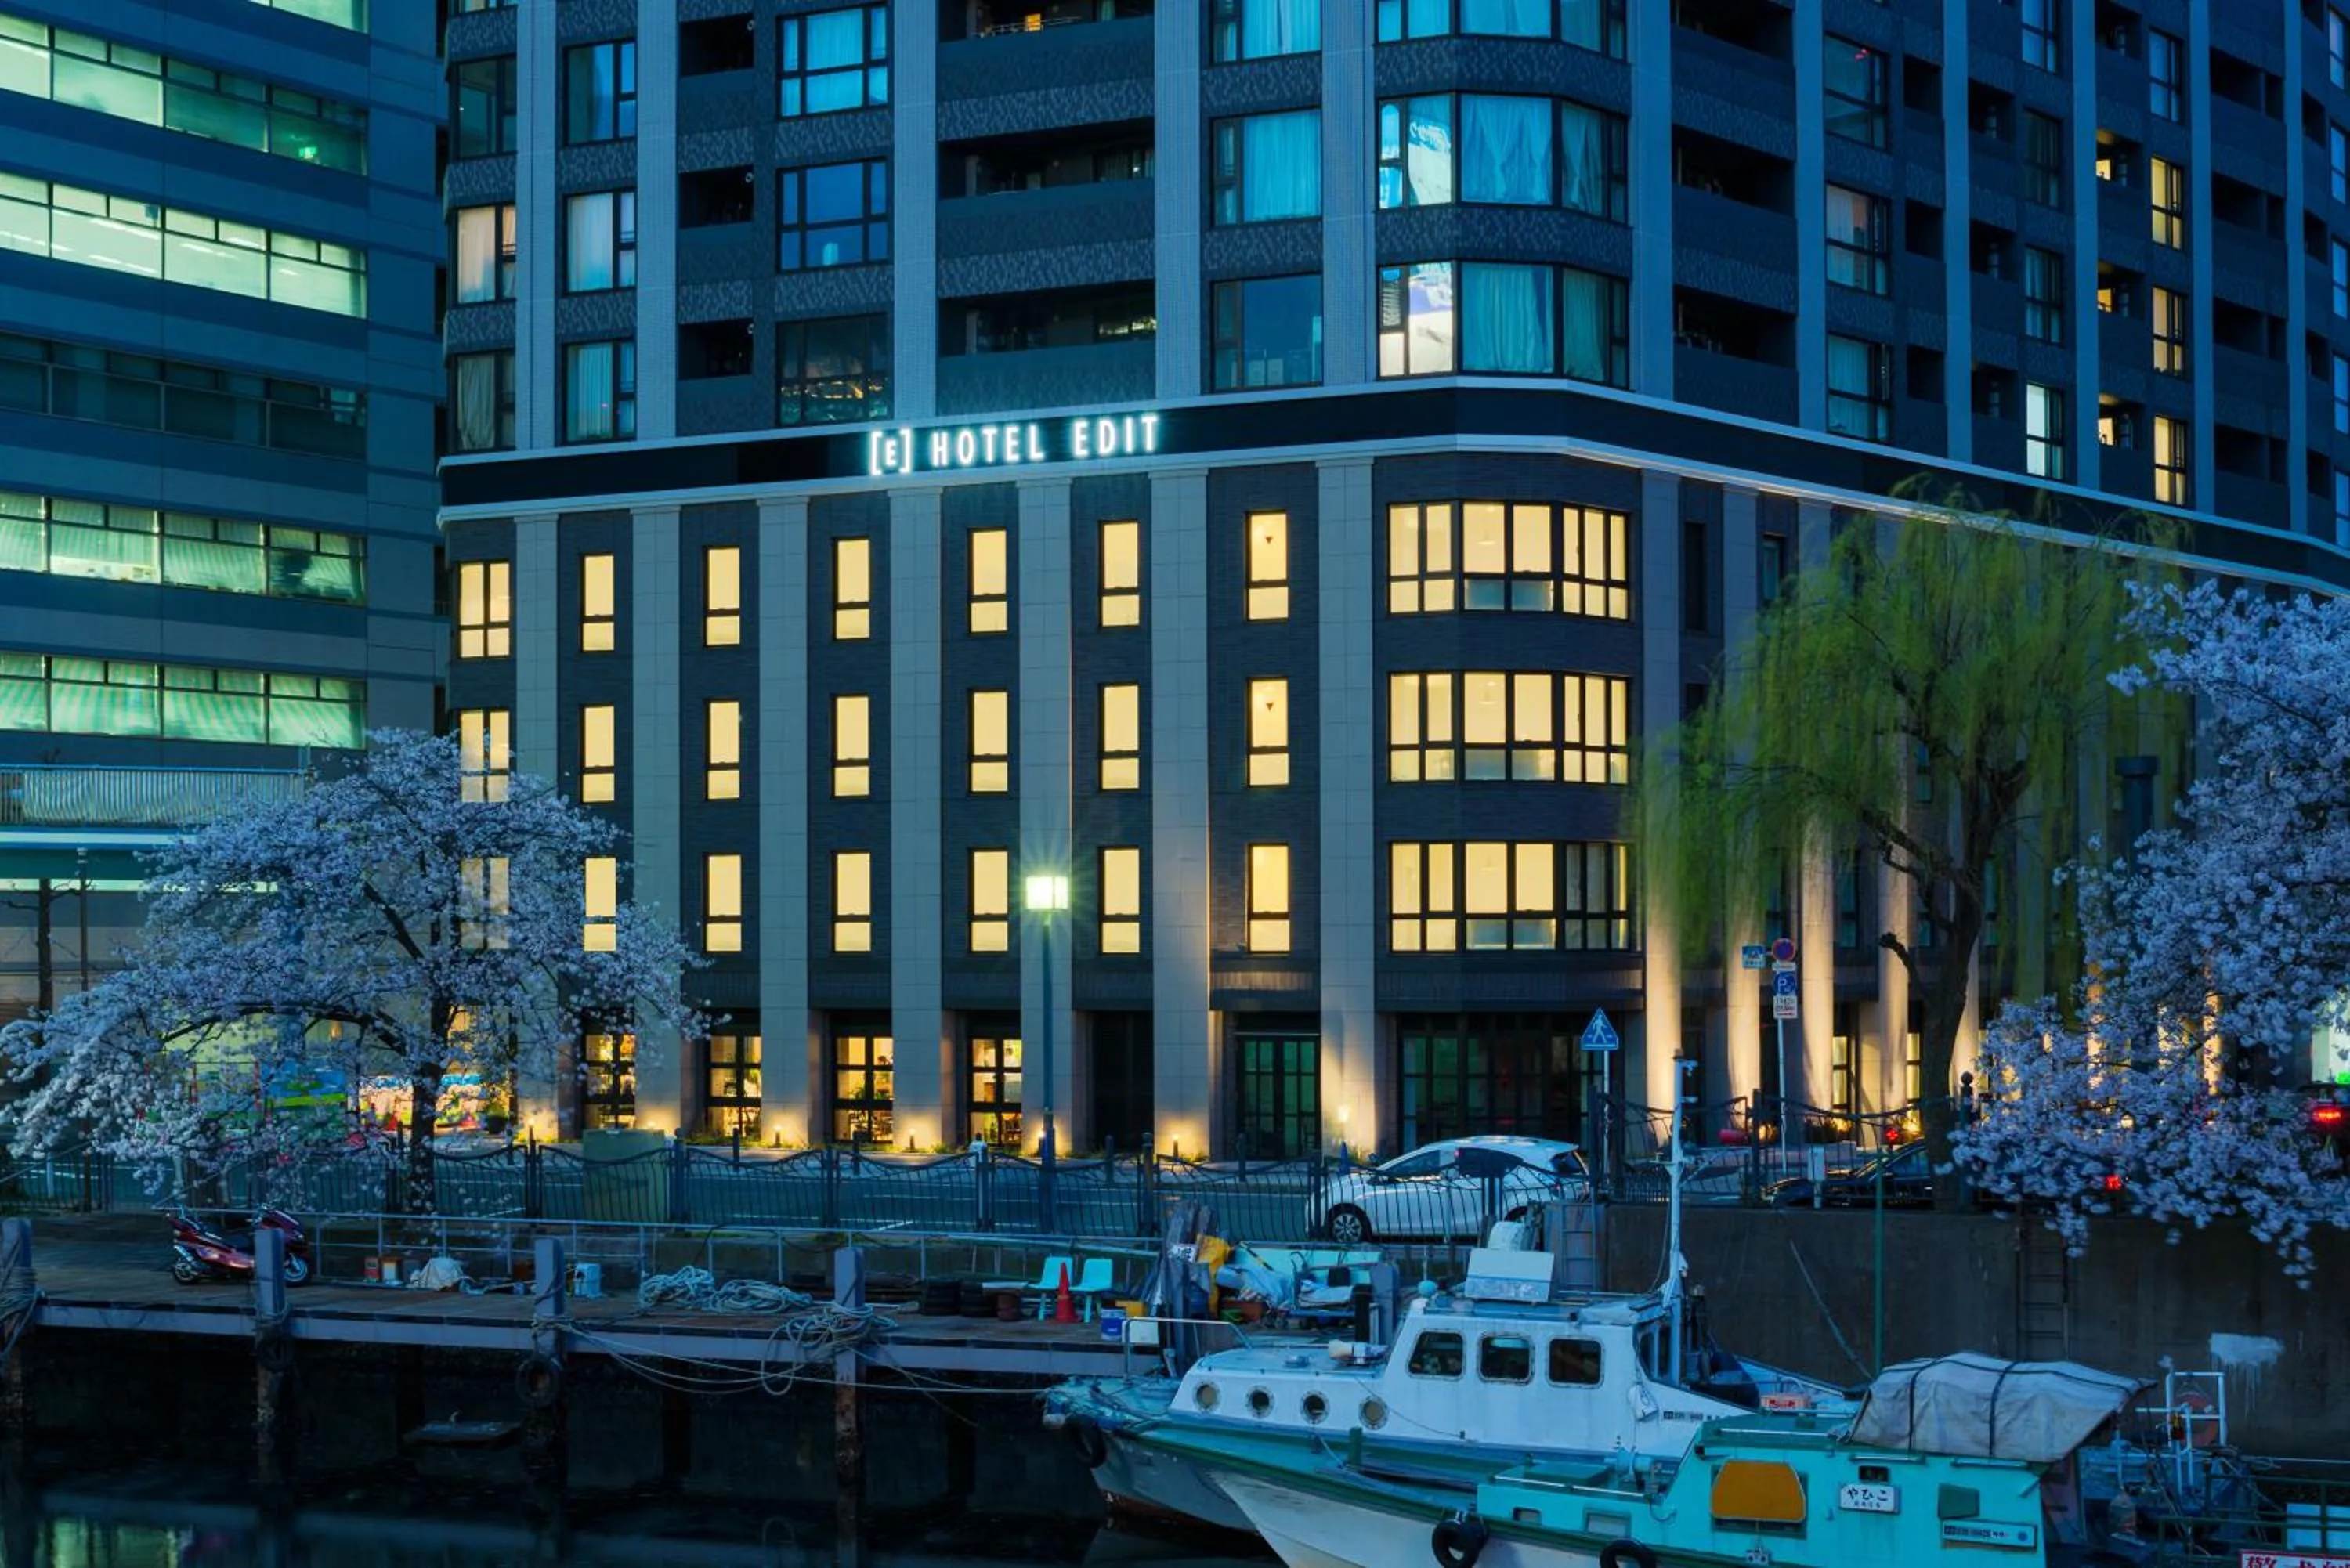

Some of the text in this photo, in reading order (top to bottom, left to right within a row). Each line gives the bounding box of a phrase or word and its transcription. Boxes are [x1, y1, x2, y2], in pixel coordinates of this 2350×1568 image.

[931, 424, 1045, 468] HOTEL
[1072, 414, 1159, 457] EDIT
[1777, 977, 1788, 995] P
[1847, 1486, 1889, 1501] やひこ
